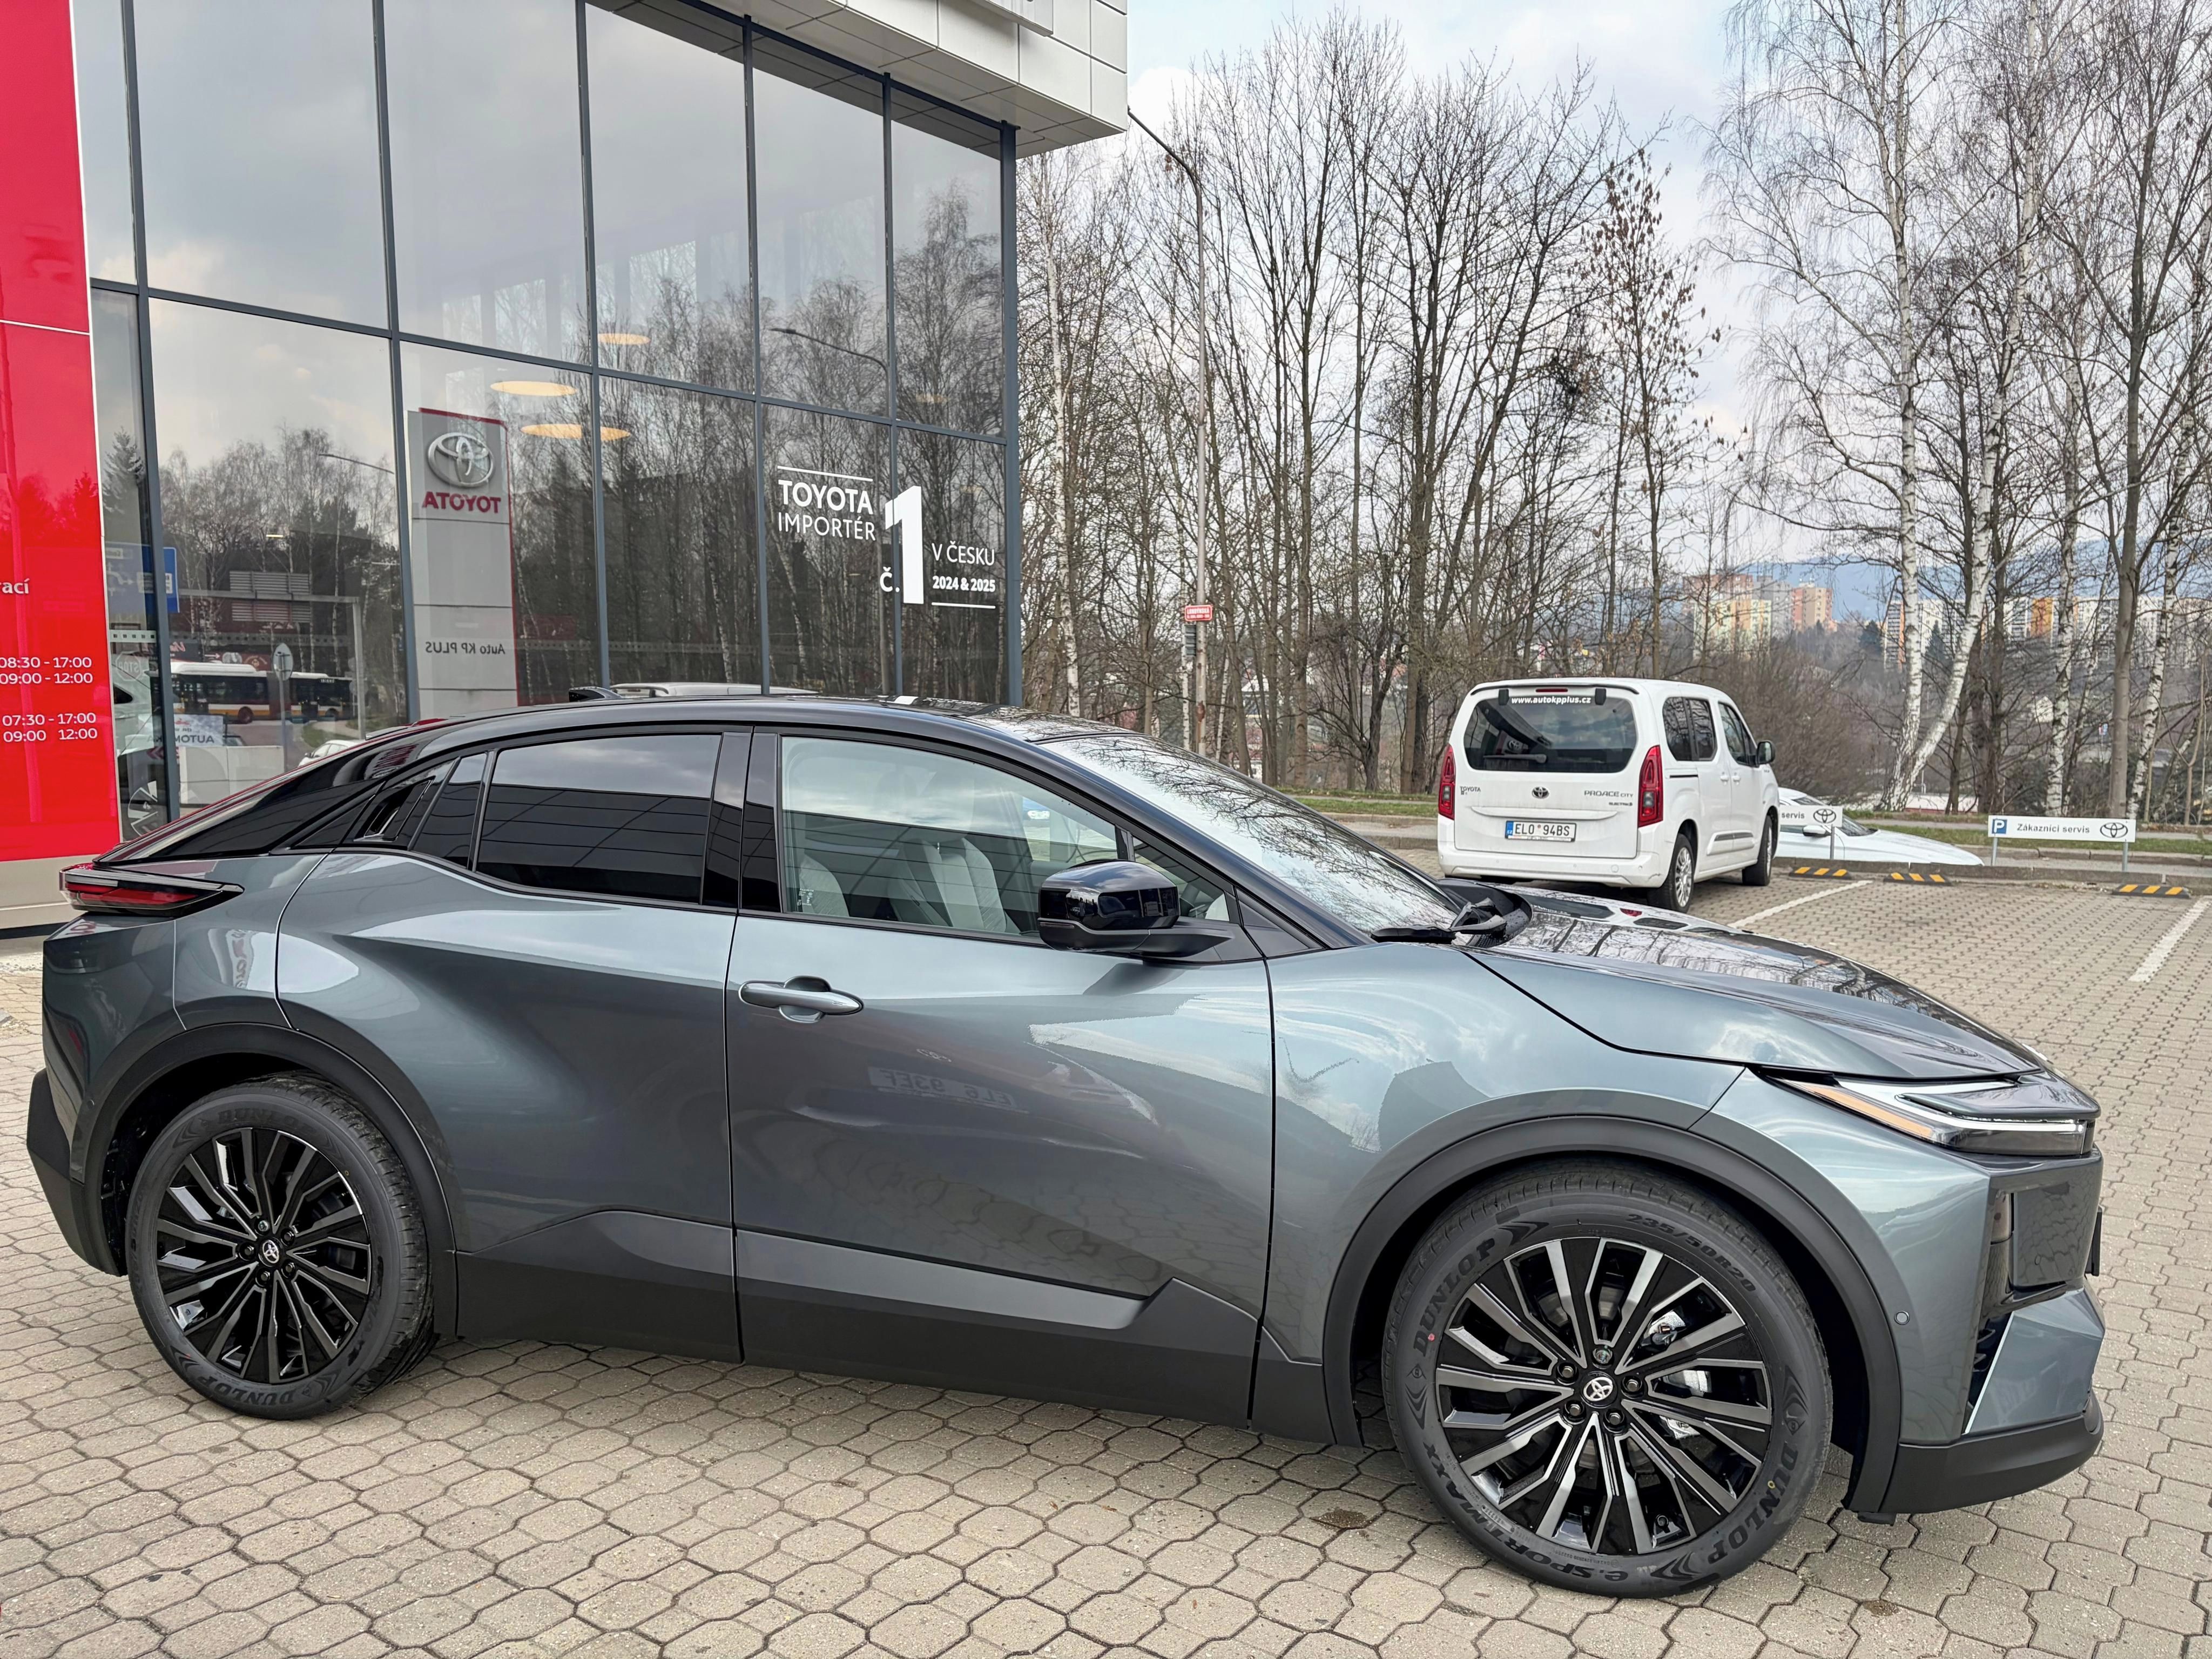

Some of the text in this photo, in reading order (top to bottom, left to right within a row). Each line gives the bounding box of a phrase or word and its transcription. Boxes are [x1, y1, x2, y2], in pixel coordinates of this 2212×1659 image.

[778, 480, 873, 515] TOYOTA
[778, 512, 876, 541] IMPORTÉR
[885, 485, 924, 604] 1
[932, 541, 995, 566] V ČESKU
[933, 576, 996, 592] 2024 & 2025
[0, 657, 41, 668] 08:30
[53, 657, 92, 668] 17:00
[0, 673, 42, 684] 09:00
[53, 672, 93, 684] 12:00
[1511, 696, 1591, 705] www.autokpplus.cz
[2, 714, 45, 726] 07:30
[57, 712, 96, 724] 17:00
[3, 728, 98, 743] 09:00 12:00
[1542, 824, 1570, 837] 94BS
[1993, 820, 2005, 833] P
[2062, 825, 2090, 833] servis
[1627, 1212, 1758, 1293] 235/50R20
[1413, 1237, 1496, 1355] DUNLOP
[198, 1373, 298, 1405] DUNLOP
[1707, 1440, 1798, 1566] DUNLOP
